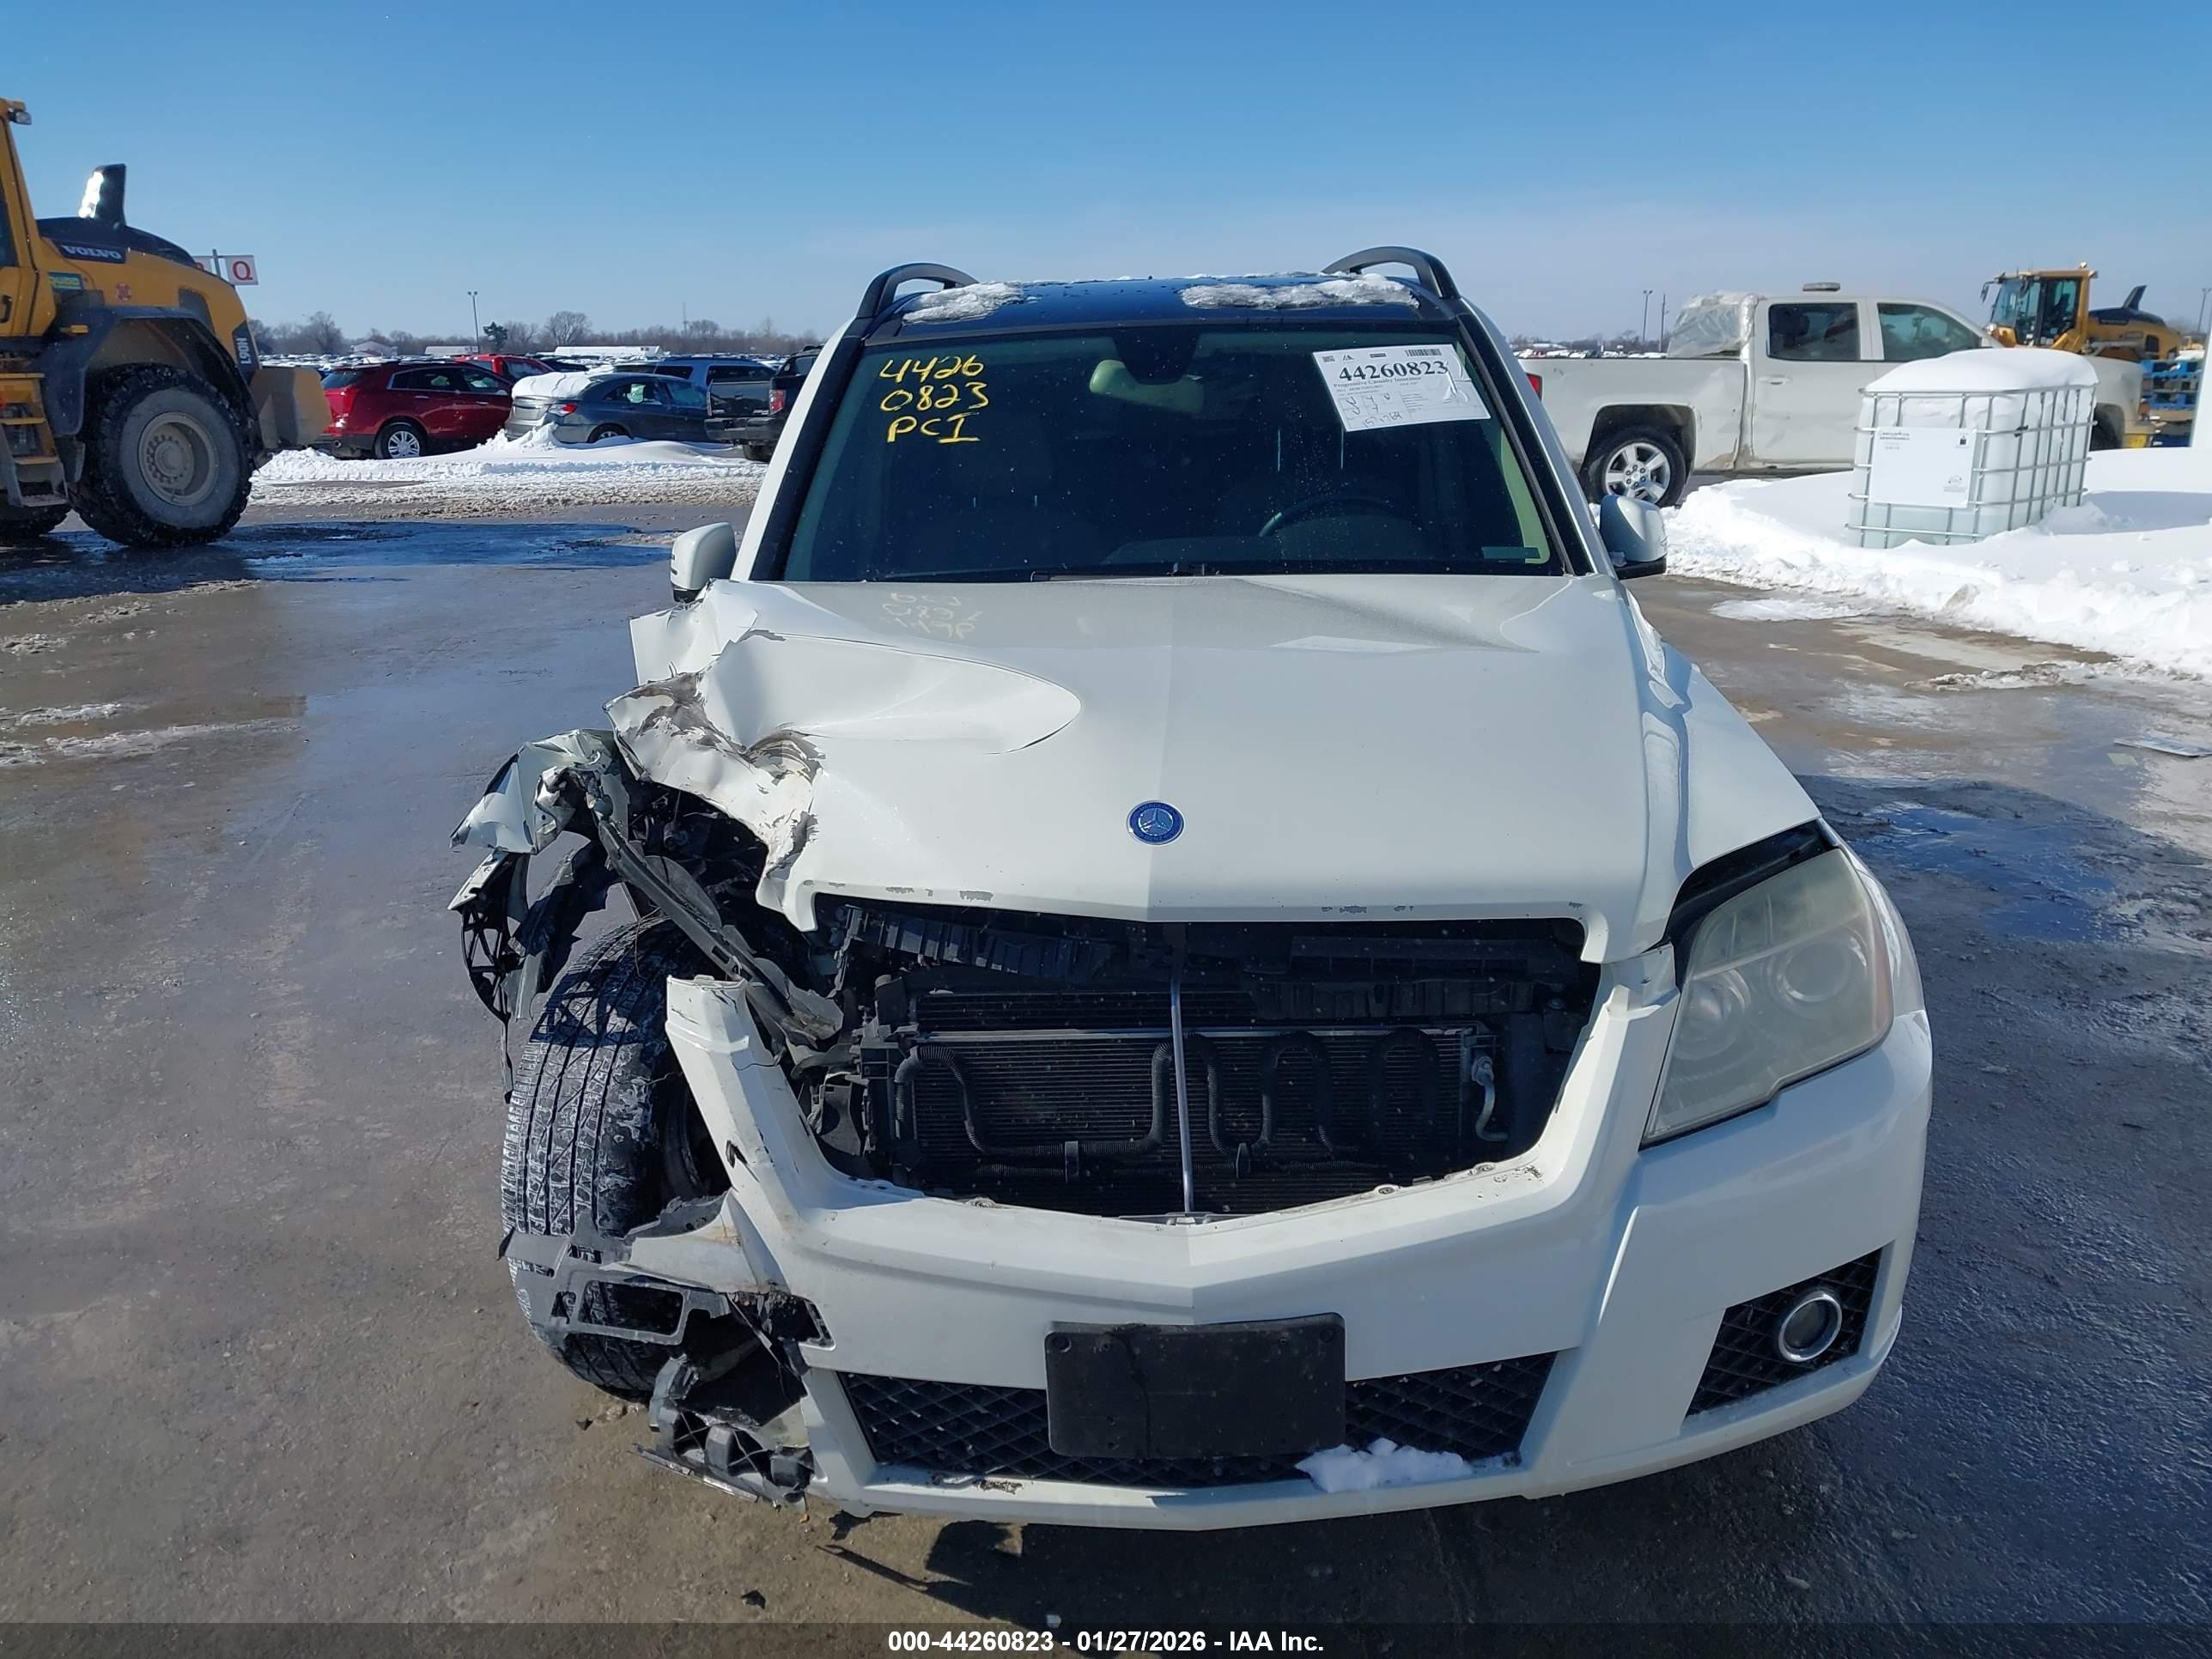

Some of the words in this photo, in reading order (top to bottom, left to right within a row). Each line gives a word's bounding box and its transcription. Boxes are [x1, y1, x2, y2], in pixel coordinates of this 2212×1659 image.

[61, 245, 123, 260] VOLVO
[232, 260, 253, 281] Q
[236, 337, 252, 365] L90H
[879, 354, 984, 383] 4426
[1340, 360, 1449, 381] 44260823
[879, 381, 989, 412] 0823
[886, 411, 981, 444] PCI
